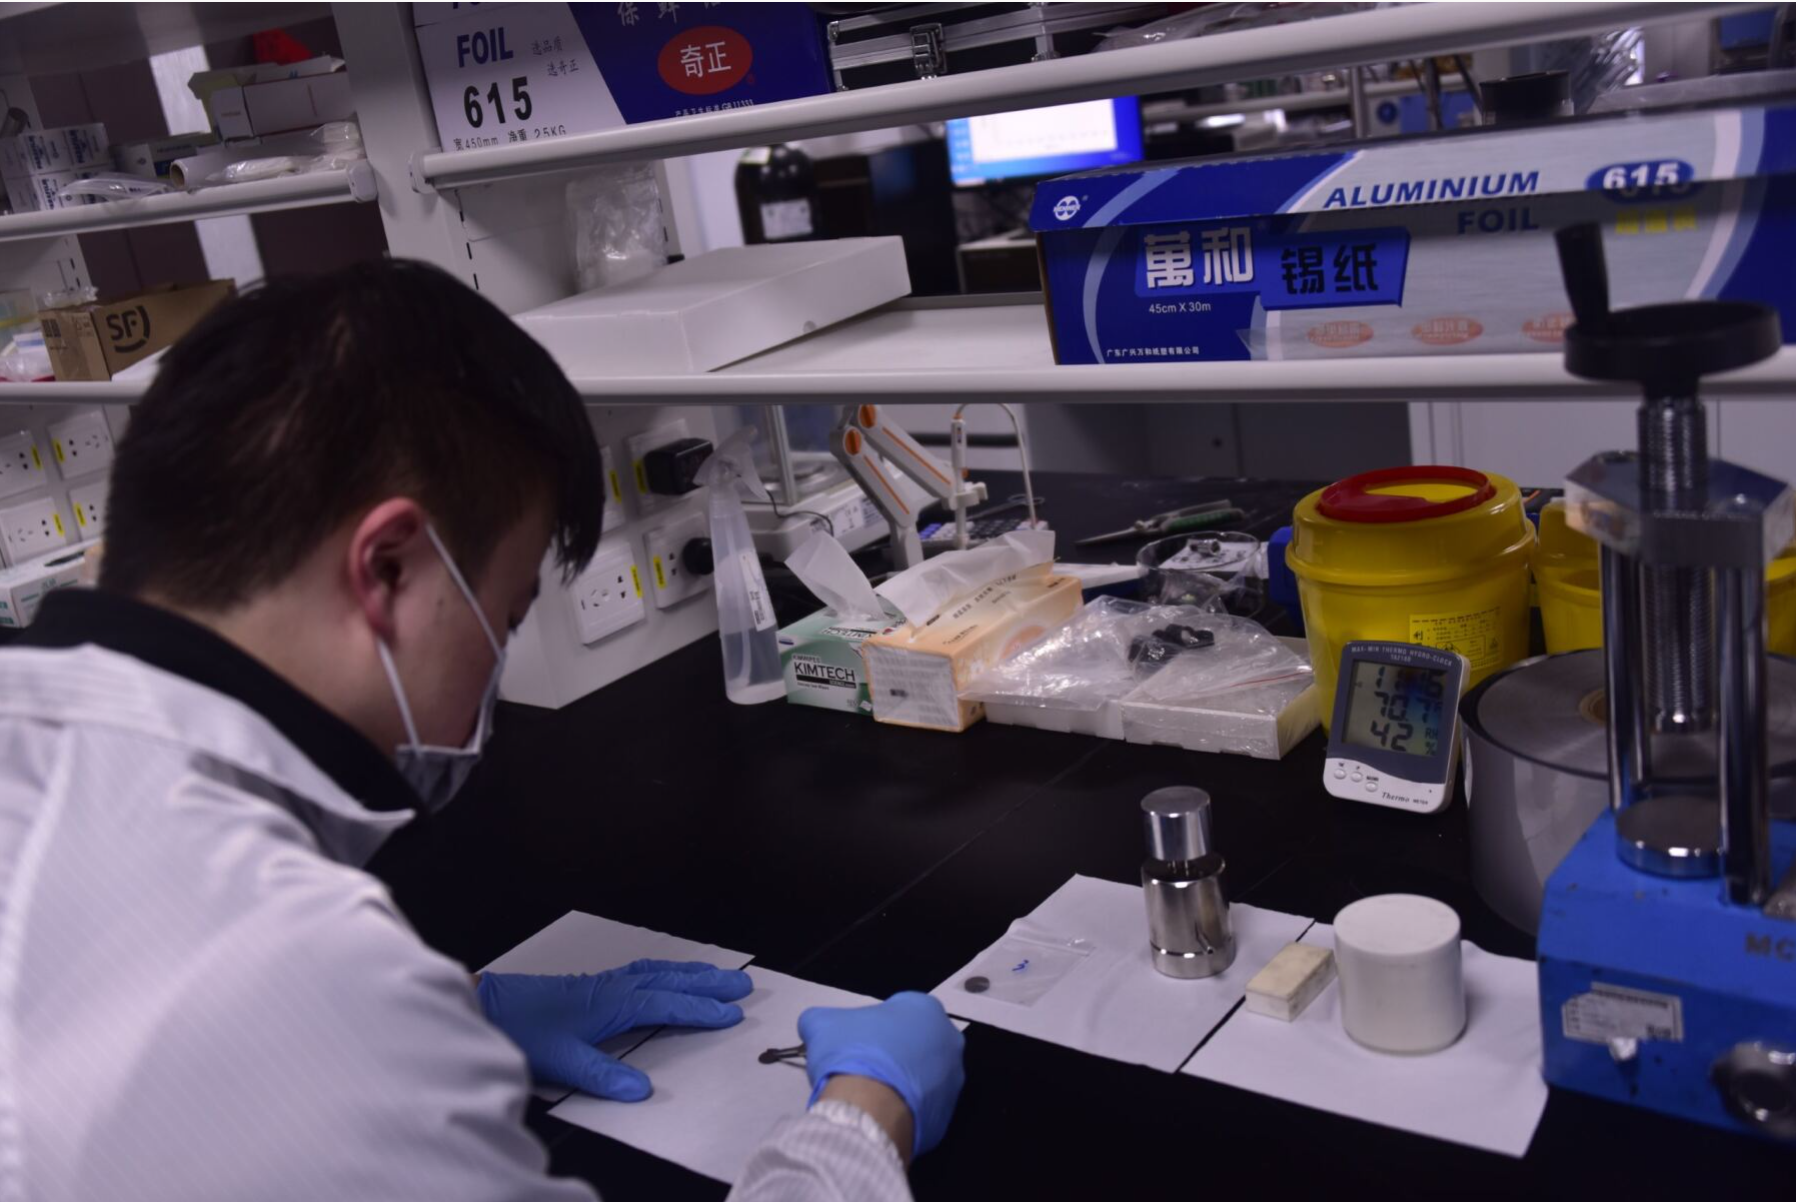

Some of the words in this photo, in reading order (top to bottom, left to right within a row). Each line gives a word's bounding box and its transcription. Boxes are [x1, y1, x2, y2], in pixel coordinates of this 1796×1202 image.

[617, 3, 721, 25] 保鲜
[457, 27, 514, 68] FOIL
[680, 41, 732, 78] 奇正
[464, 75, 532, 128] 615
[1323, 171, 1541, 209] ALUMINIUM
[1602, 162, 1680, 190] 615
[1458, 206, 1541, 234] FOIL
[1143, 226, 1254, 289] 萬和
[1282, 243, 1379, 294] 锡纸
[1149, 303, 1177, 314] 45cm
[1178, 302, 1187, 313] X
[1188, 301, 1212, 313] 30m
[106, 308, 141, 342] SF
[1382, 646, 1408, 656] THERMO
[794, 661, 857, 682] KIMTECH
[1370, 719, 1414, 752] 42
[1382, 791, 1410, 803] Thermo
